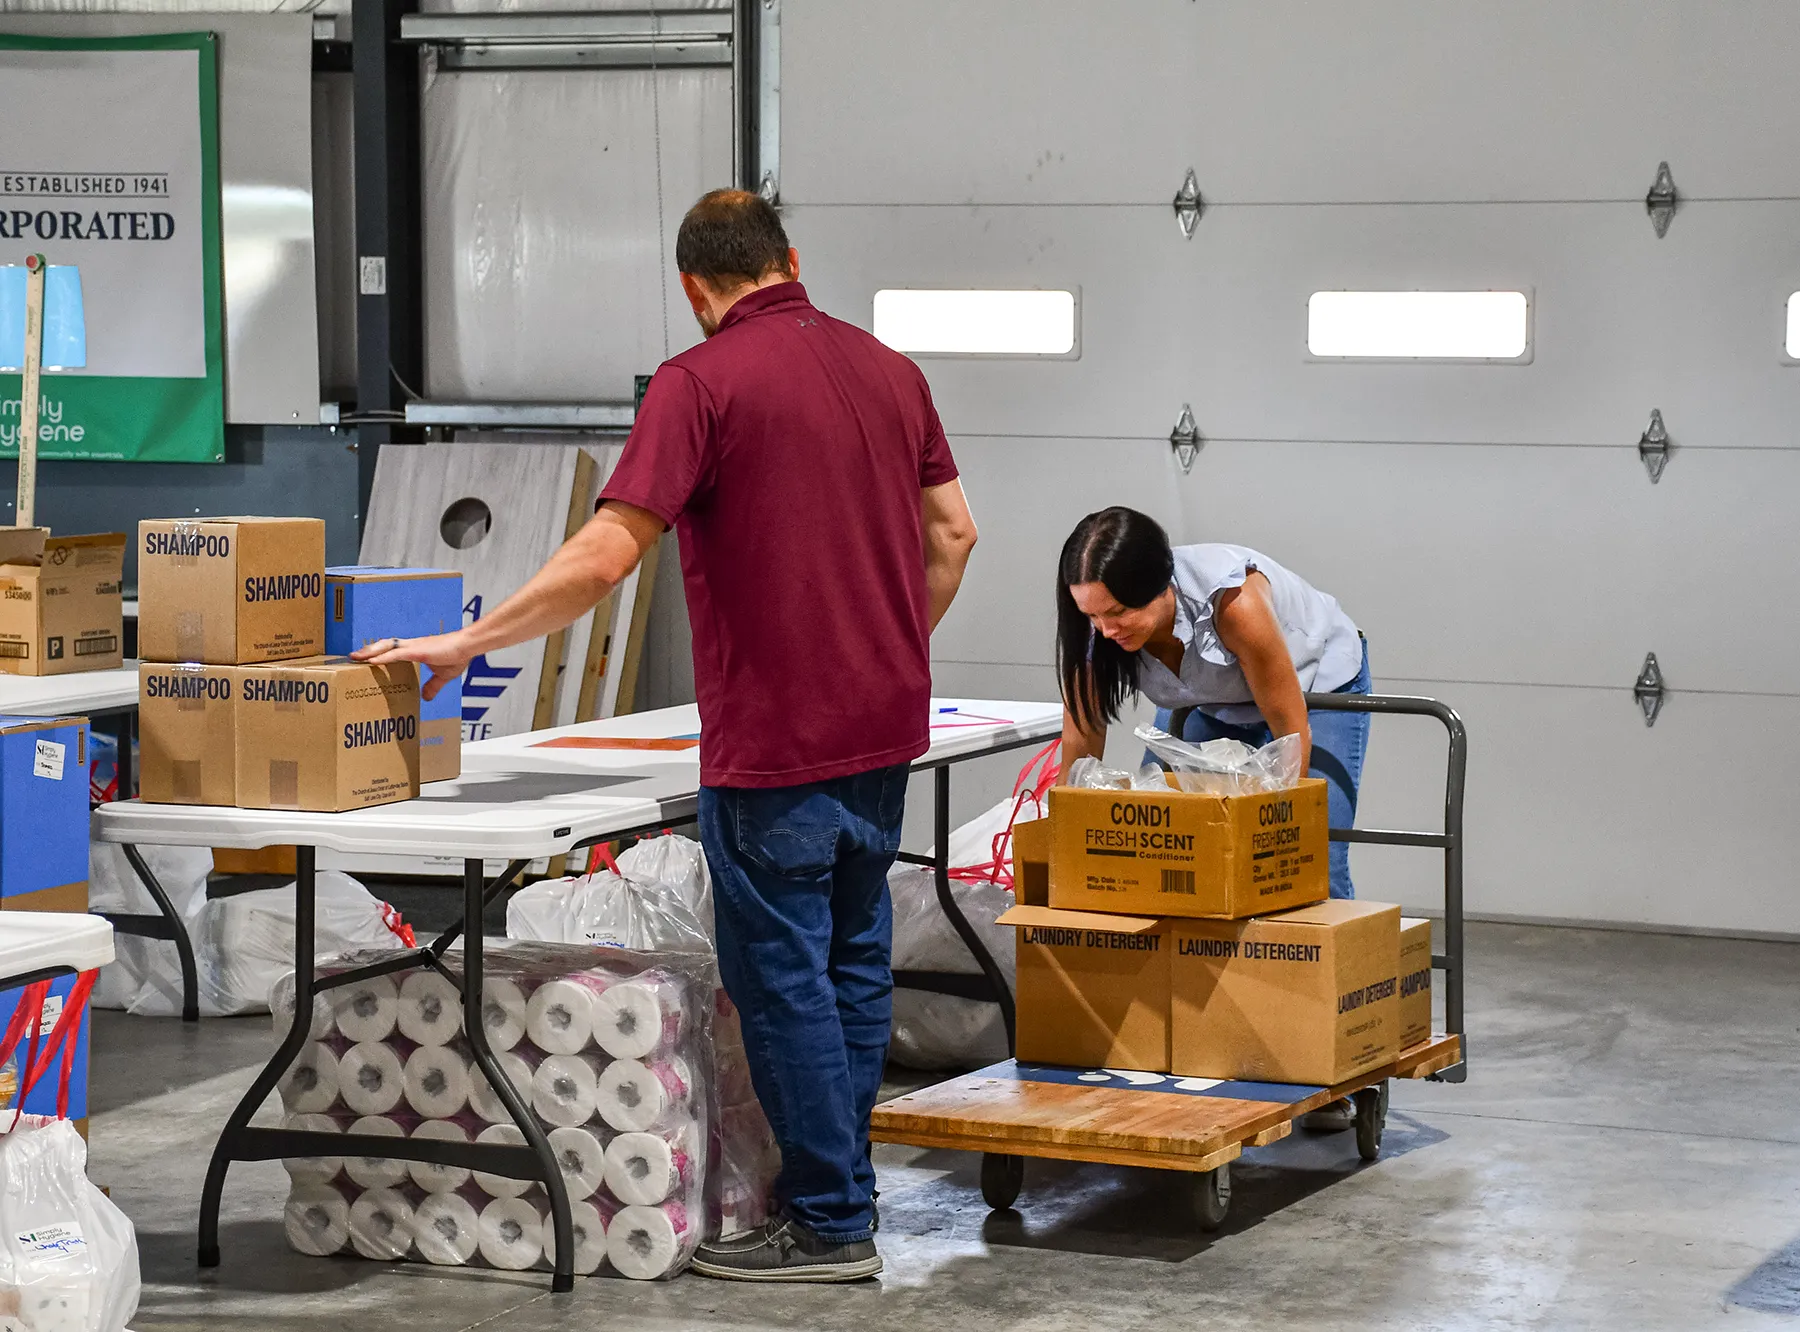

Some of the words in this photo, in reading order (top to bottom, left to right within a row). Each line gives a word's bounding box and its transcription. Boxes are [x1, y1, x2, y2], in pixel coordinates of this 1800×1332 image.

[4, 176, 125, 193] ESTABLISHED
[134, 178, 168, 193] 1941
[146, 532, 230, 557] SHAMPOO
[245, 573, 320, 602] SHAMPOO
[147, 675, 231, 700] SHAMPOO
[243, 679, 329, 703] SHAMPOO
[344, 715, 416, 749] SHAMPOO
[1111, 803, 1170, 828] COND1
[1260, 800, 1293, 827] COND1
[1086, 829, 1137, 848] FRESH
[1140, 832, 1195, 851] SCENT
[1253, 830, 1275, 849] FRESH
[1276, 826, 1300, 846] SCENT
[1139, 852, 1195, 862] Conditioner
[1023, 928, 1081, 947] LAUNDRY
[1086, 930, 1160, 951] DETERGENT
[1179, 938, 1239, 958] LAUNDRY
[1244, 942, 1321, 963] DETERGENT
[1338, 988, 1364, 1014] LAUNDRY
[1365, 977, 1397, 1005] DETERGENT
